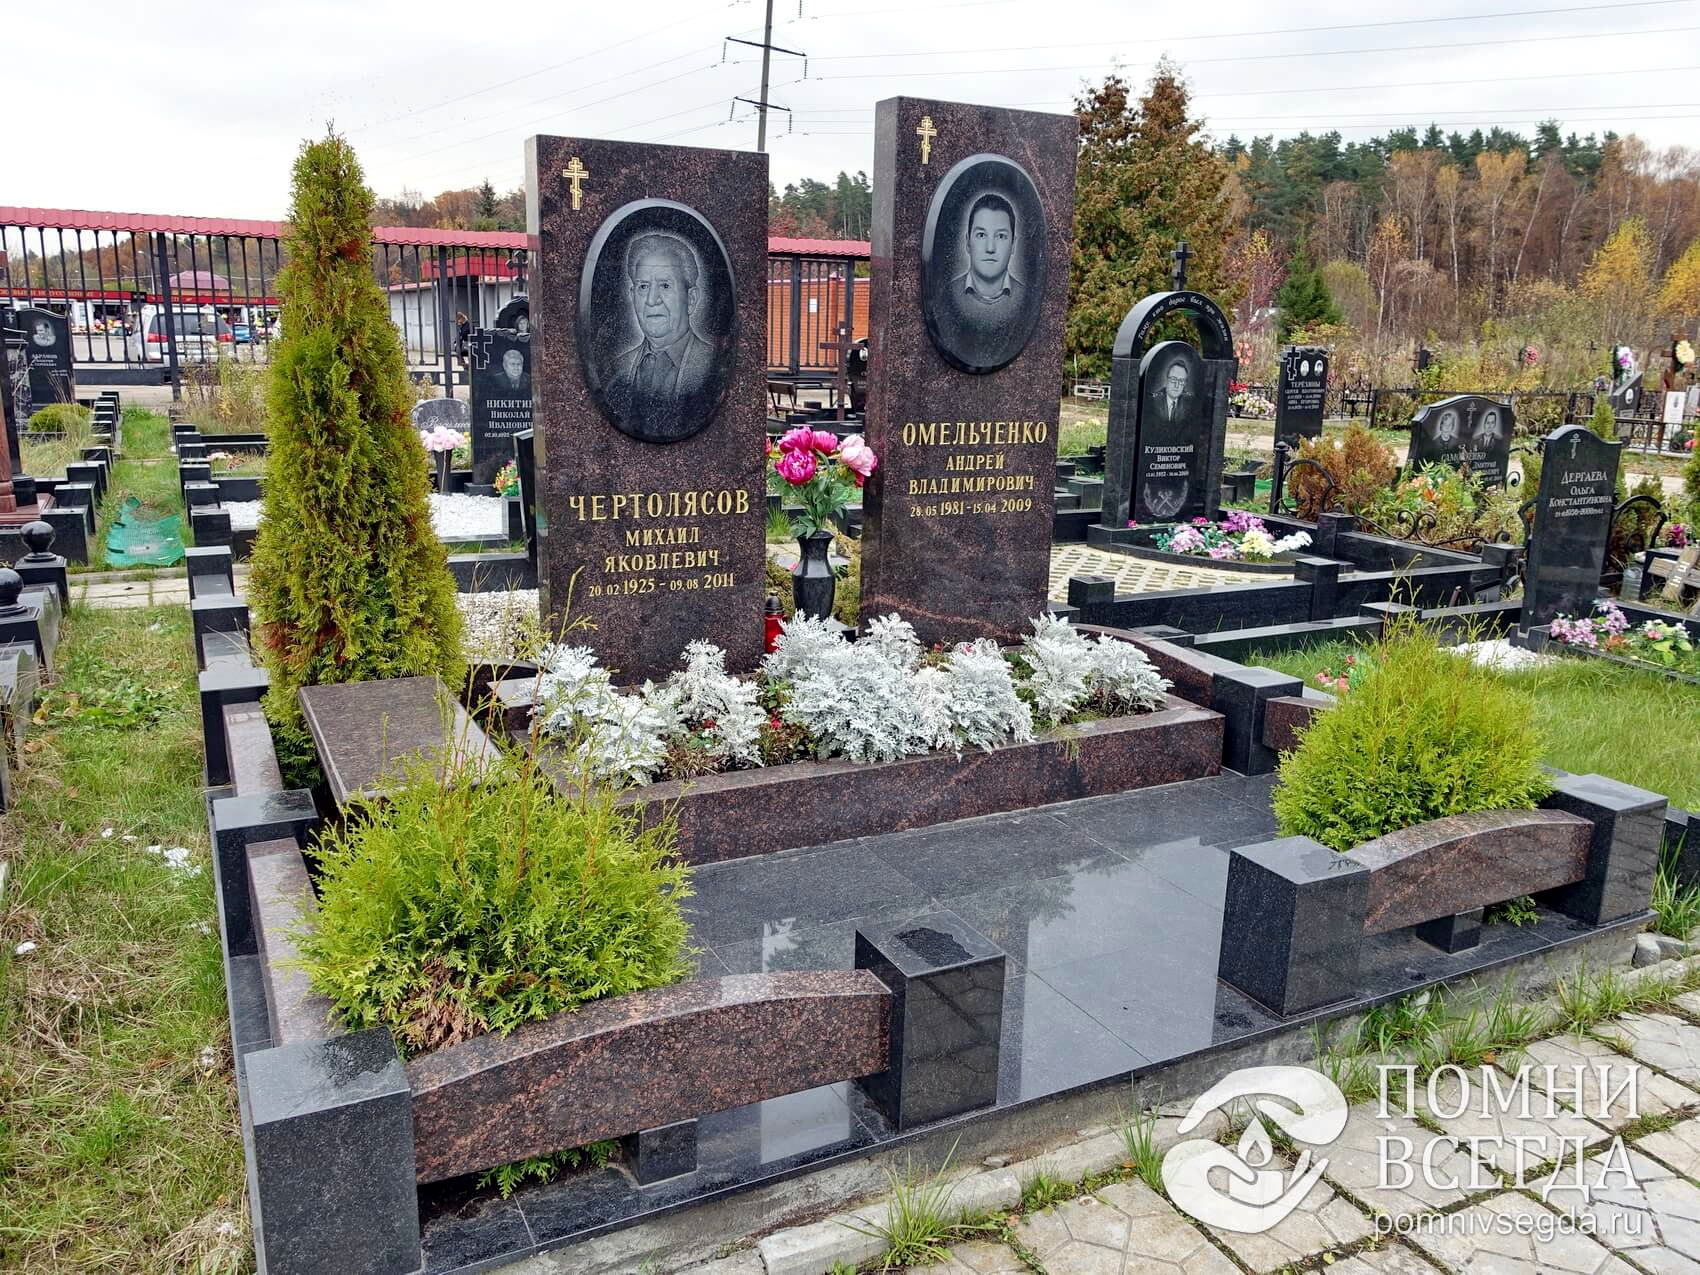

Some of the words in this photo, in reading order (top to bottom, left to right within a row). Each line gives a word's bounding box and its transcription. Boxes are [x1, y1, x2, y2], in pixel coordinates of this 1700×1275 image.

[491, 410, 531, 418] НИКОЛАЙ
[902, 421, 1048, 447] ОМЕЛЬЧЕНКО
[1144, 444, 1194, 454] КУЛИКОВСКИЙ
[946, 451, 1005, 471] АНДРЕЙ
[909, 475, 1035, 495] ВЛАДИМИРОВИЧ
[1561, 470, 1608, 484] ДЕРГАЕВА
[1570, 486, 1596, 496] ОЛЬГА
[568, 489, 750, 521] ЧЕРТОЛЯСОВ
[1001, 497, 1033, 513] 2009
[1548, 495, 1613, 508] КОНСТАНТИНОВНА
[626, 526, 700, 547] МИХАИЛ
[604, 550, 720, 574] ЯКОВЛЕВИЧ
[703, 572, 735, 589] 2011
